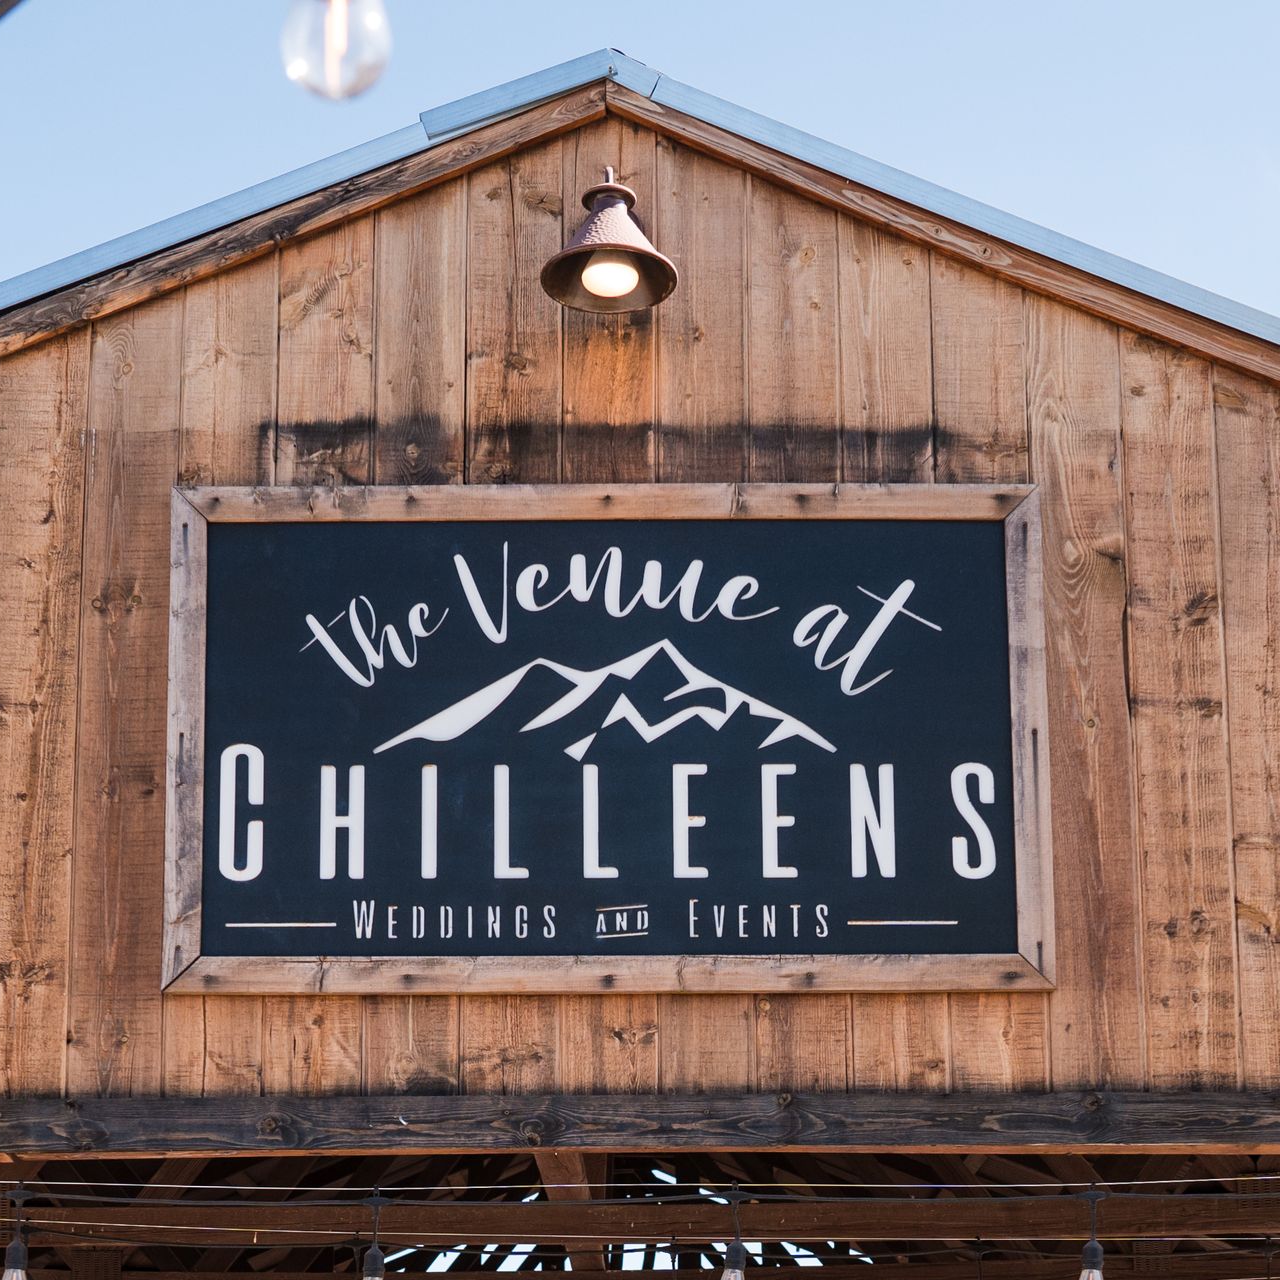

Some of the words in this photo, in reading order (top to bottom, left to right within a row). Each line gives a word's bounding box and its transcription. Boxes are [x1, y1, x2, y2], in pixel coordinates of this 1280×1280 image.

[300, 594, 450, 688] the
[453, 541, 781, 646] Venue
[793, 579, 943, 696] at
[218, 743, 998, 883] CHILLEENS
[352, 899, 558, 940] WEDDINGS
[596, 910, 649, 934] AND
[689, 898, 830, 940] EVENTS
